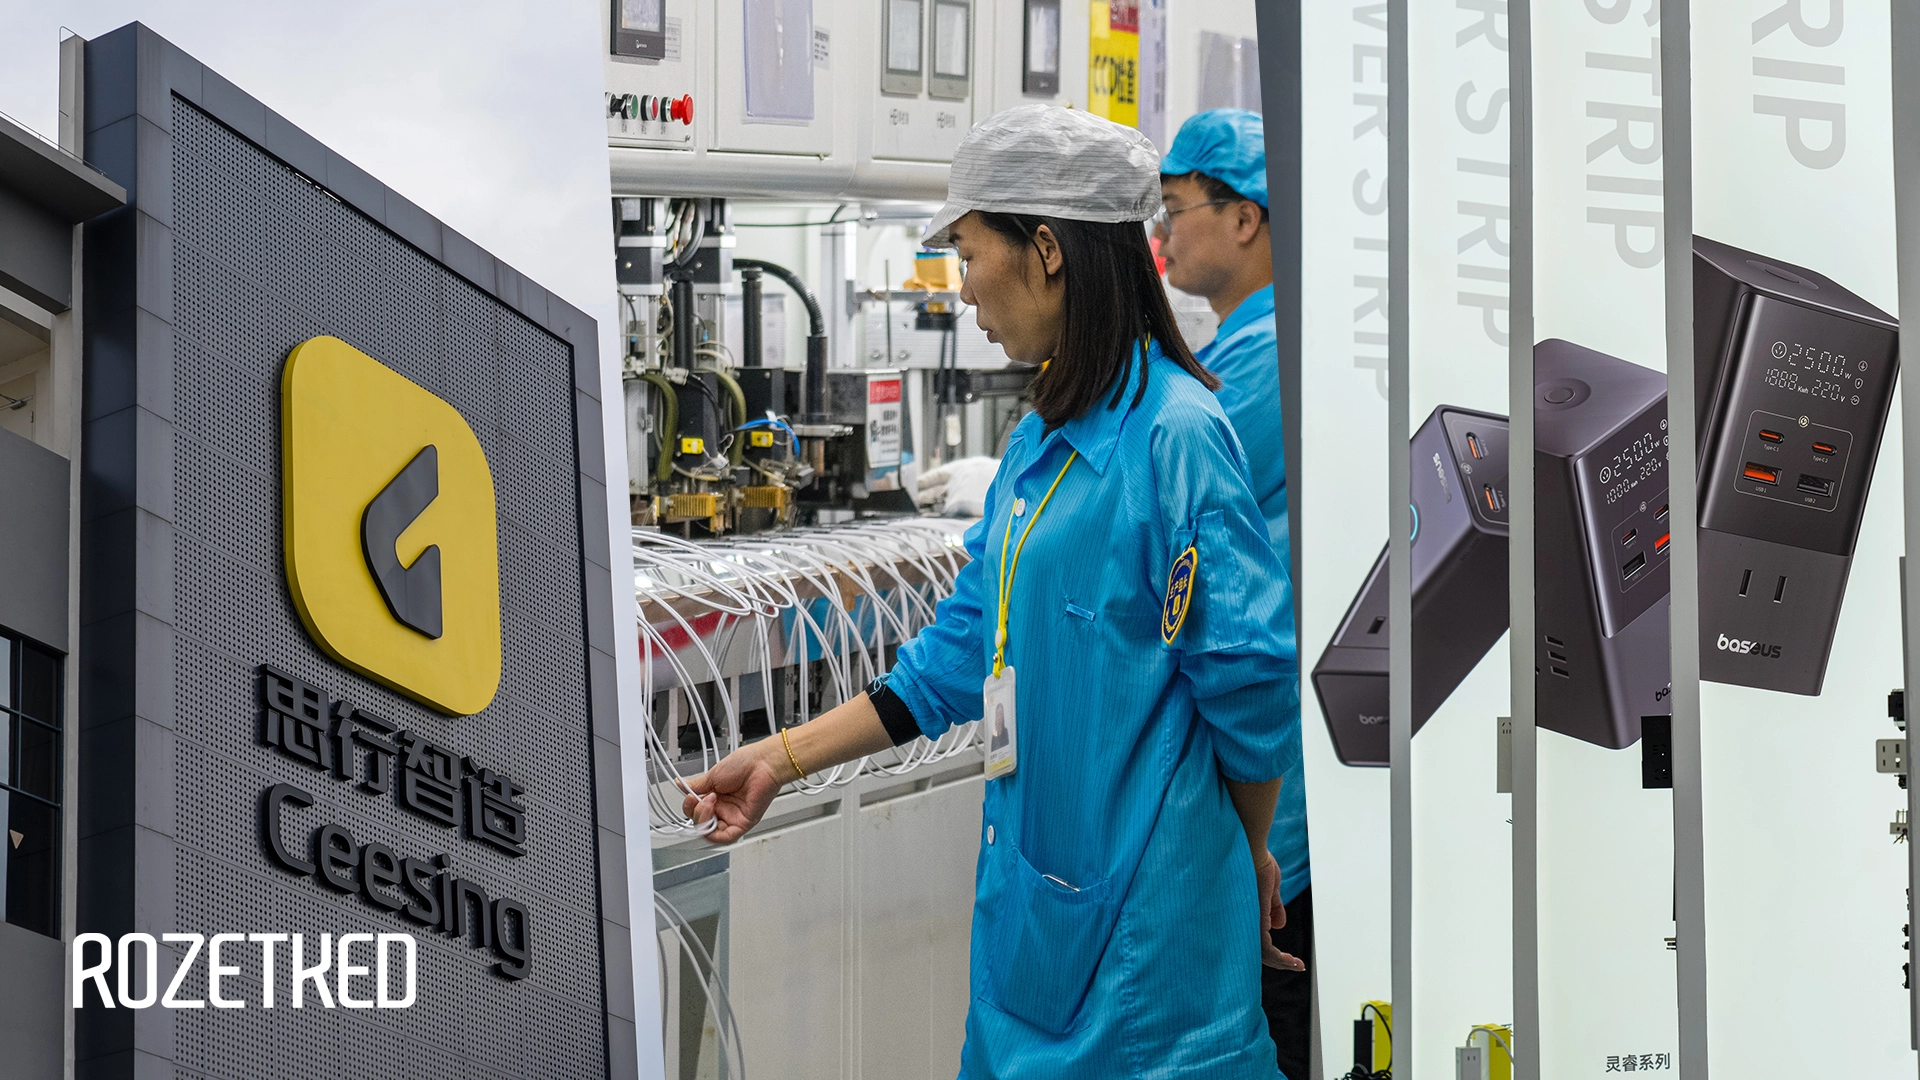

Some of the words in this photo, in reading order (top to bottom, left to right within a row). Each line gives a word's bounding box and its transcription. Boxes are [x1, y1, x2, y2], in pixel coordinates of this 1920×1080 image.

[1717, 633, 1782, 659] baseus
[259, 663, 527, 857] 思行智造
[263, 783, 531, 981] Ceesing
[1605, 1052, 1671, 1073] 灵睿系列
